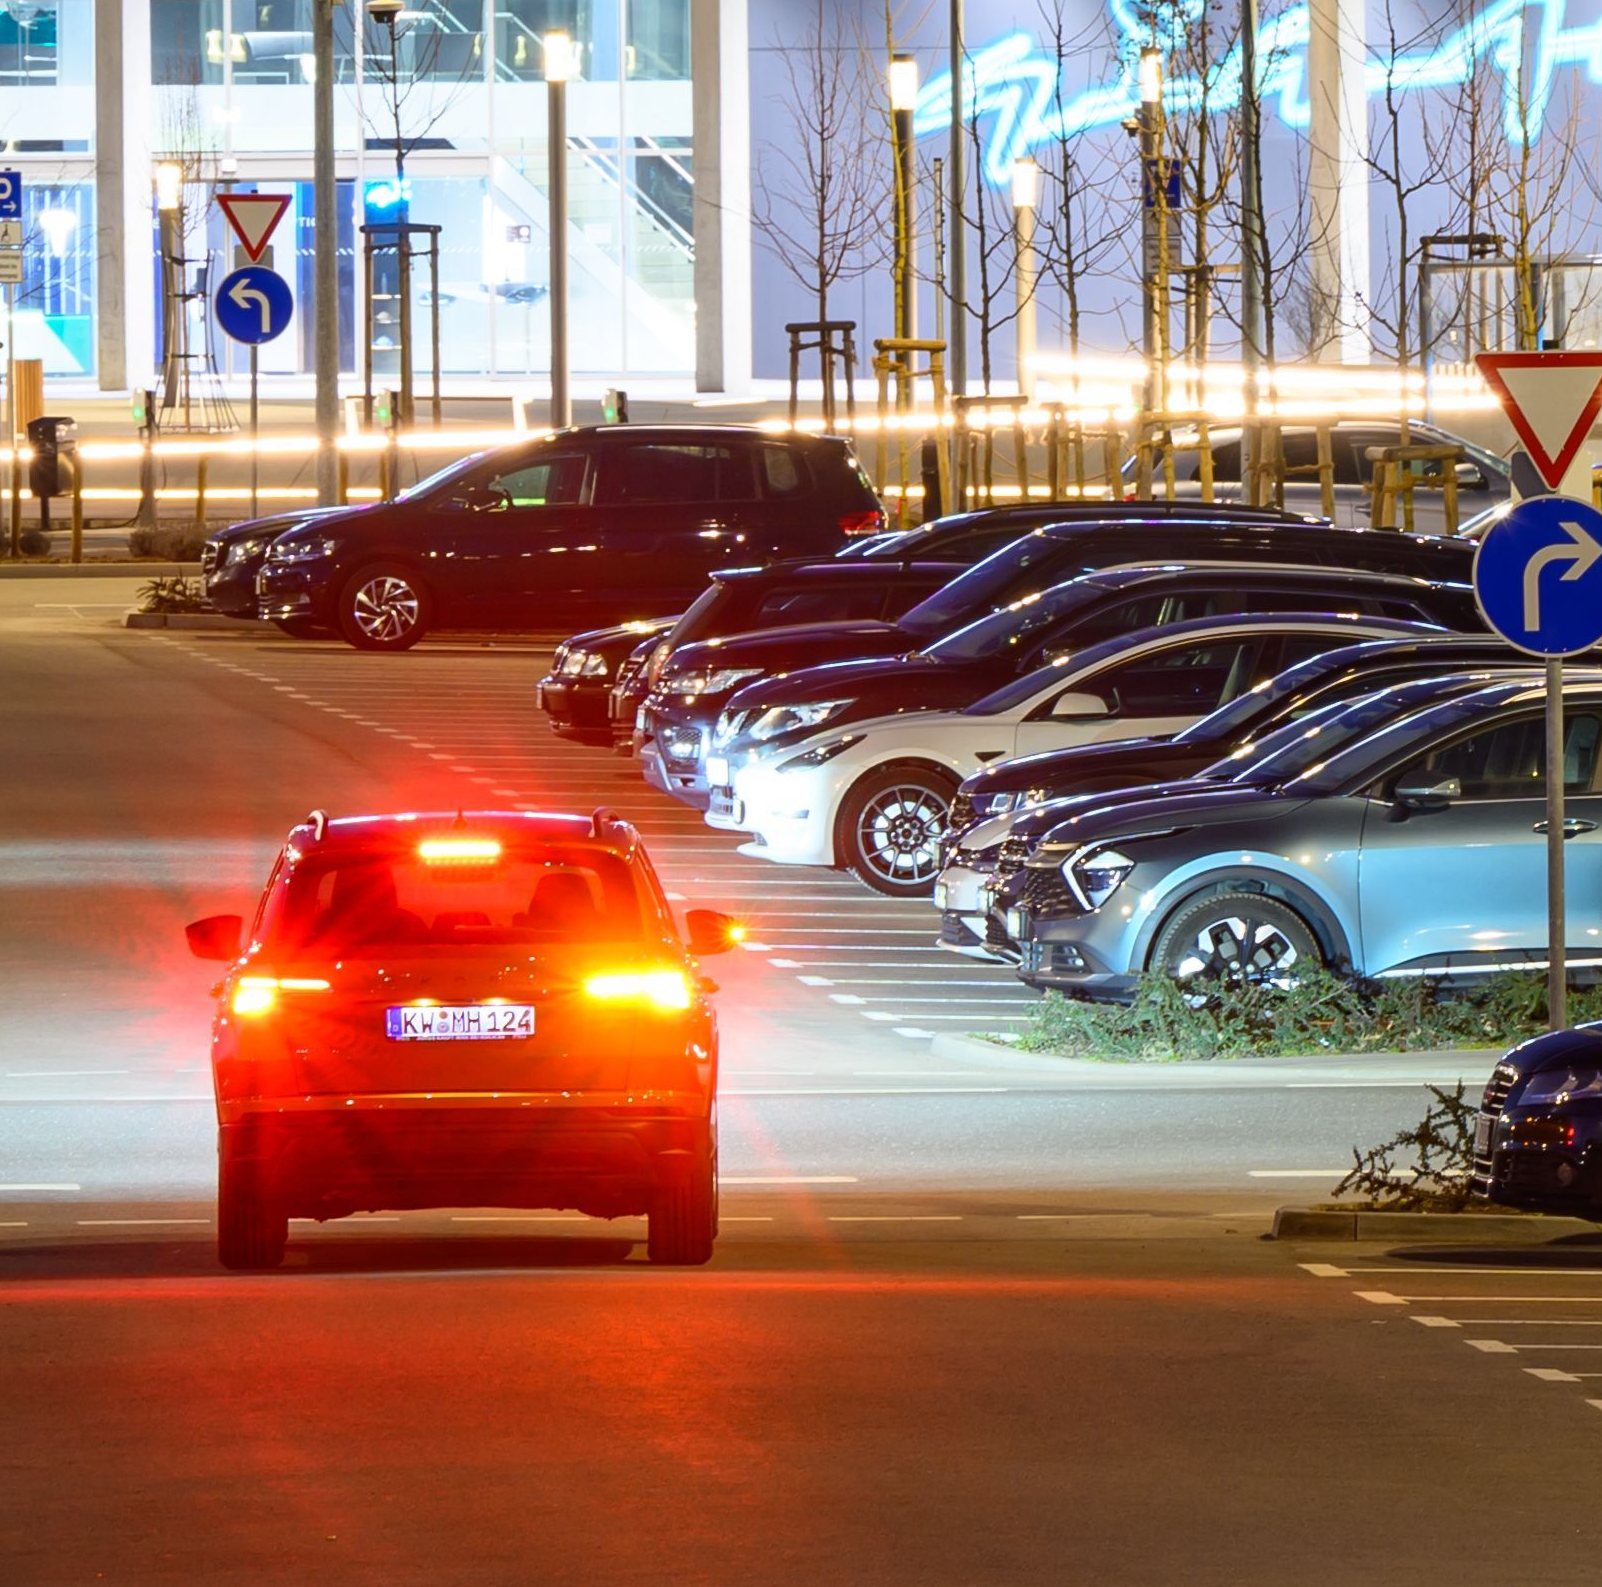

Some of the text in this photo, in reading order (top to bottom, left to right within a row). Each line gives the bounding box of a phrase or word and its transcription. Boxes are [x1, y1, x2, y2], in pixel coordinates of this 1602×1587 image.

[403, 1012, 435, 1034] KW
[452, 1010, 481, 1033] MH
[487, 1010, 531, 1032] 124
